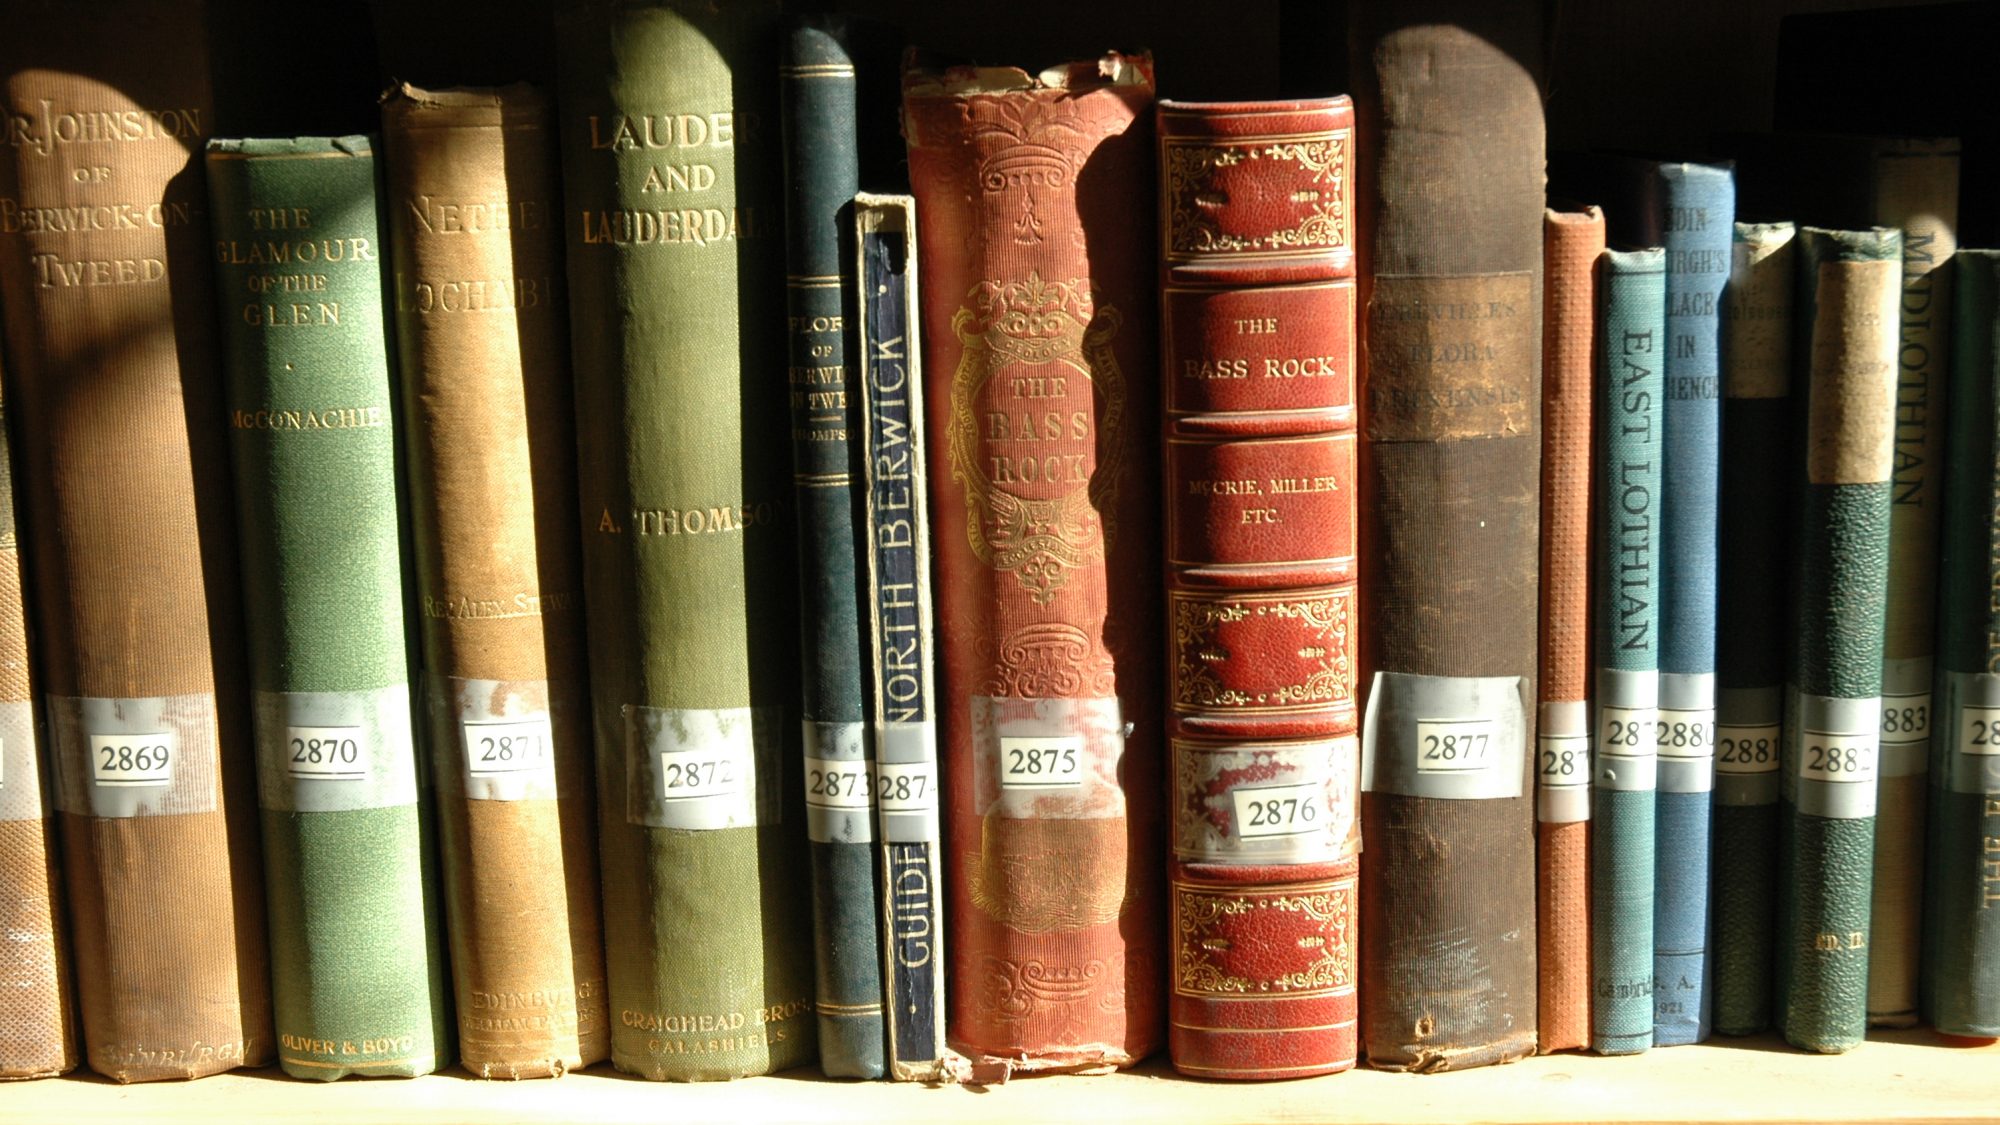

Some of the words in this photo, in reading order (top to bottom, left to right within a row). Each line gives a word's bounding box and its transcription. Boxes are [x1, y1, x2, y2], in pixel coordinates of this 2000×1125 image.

[74, 167, 111, 183] OF
[642, 164, 716, 193] AND
[250, 208, 311, 229] THE
[581, 208, 770, 247] LAUDERDAL
[216, 238, 376, 264] GLAMOUR
[1666, 250, 1724, 273] URGH'S
[32, 253, 164, 287] TWEED
[248, 276, 276, 293] OF
[279, 274, 327, 292] THE
[243, 303, 341, 326] GLEN
[1667, 292, 1714, 316] LACE
[1235, 318, 1278, 334] THE
[811, 345, 833, 358] OF
[1676, 336, 1696, 358] IN
[1184, 360, 1248, 379] BASS
[1264, 357, 1336, 378] ROCK
[1893, 231, 1935, 508] MIDLOTHIAN
[1011, 377, 1067, 399] THE
[1622, 330, 1652, 443] EAST
[985, 411, 1090, 442] BASS
[871, 334, 913, 549] BERWICK
[991, 454, 1089, 484] ROCK
[1270, 477, 1338, 494] MILLER
[597, 508, 622, 534] A.
[1241, 509, 1283, 524] ETC.
[1620, 461, 1650, 651] LOTHIAN
[1880, 706, 1927, 733] 883
[1971, 719, 2000, 745] 28
[1608, 720, 1658, 746] 28
[100, 744, 169, 771] 2869
[291, 738, 357, 764] 2870
[480, 735, 542, 762] 2871
[1424, 735, 1489, 760] 2877
[1720, 738, 1779, 764] 2881
[666, 758, 735, 789] 2872
[1009, 748, 1076, 774] 2875
[1542, 750, 1594, 775] 287
[809, 770, 873, 796] 2873
[879, 775, 936, 801] 287
[1249, 799, 1316, 826] 2876
[621, 1010, 745, 1035] CRAIGHEAD
[282, 1034, 335, 1055] OLIVER
[342, 1040, 358, 1055] &
